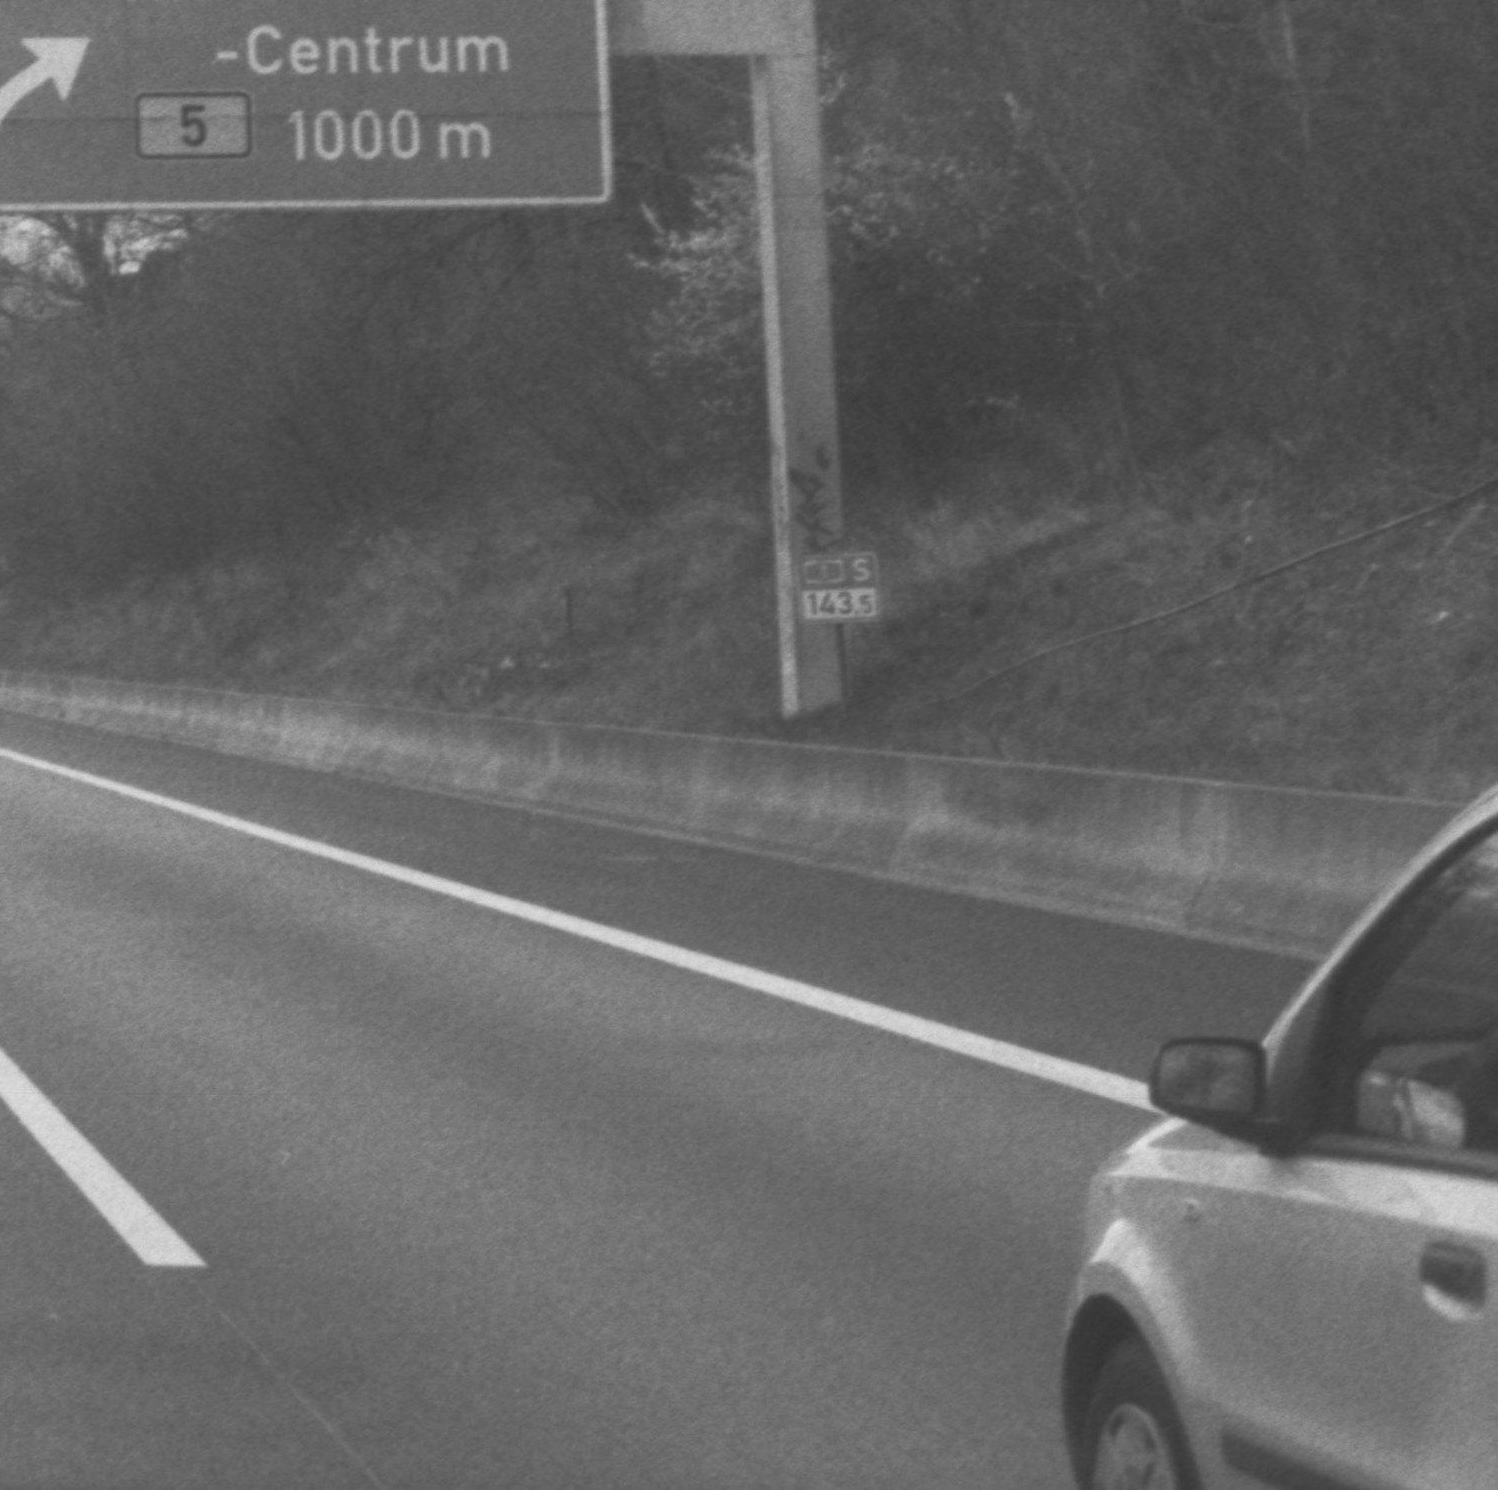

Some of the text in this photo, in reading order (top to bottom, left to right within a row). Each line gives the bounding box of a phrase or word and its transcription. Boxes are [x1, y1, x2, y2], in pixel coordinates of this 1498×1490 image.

[215, 24, 510, 76] -Centrum
[178, 105, 207, 148] 5
[288, 109, 492, 162] 1000 m
